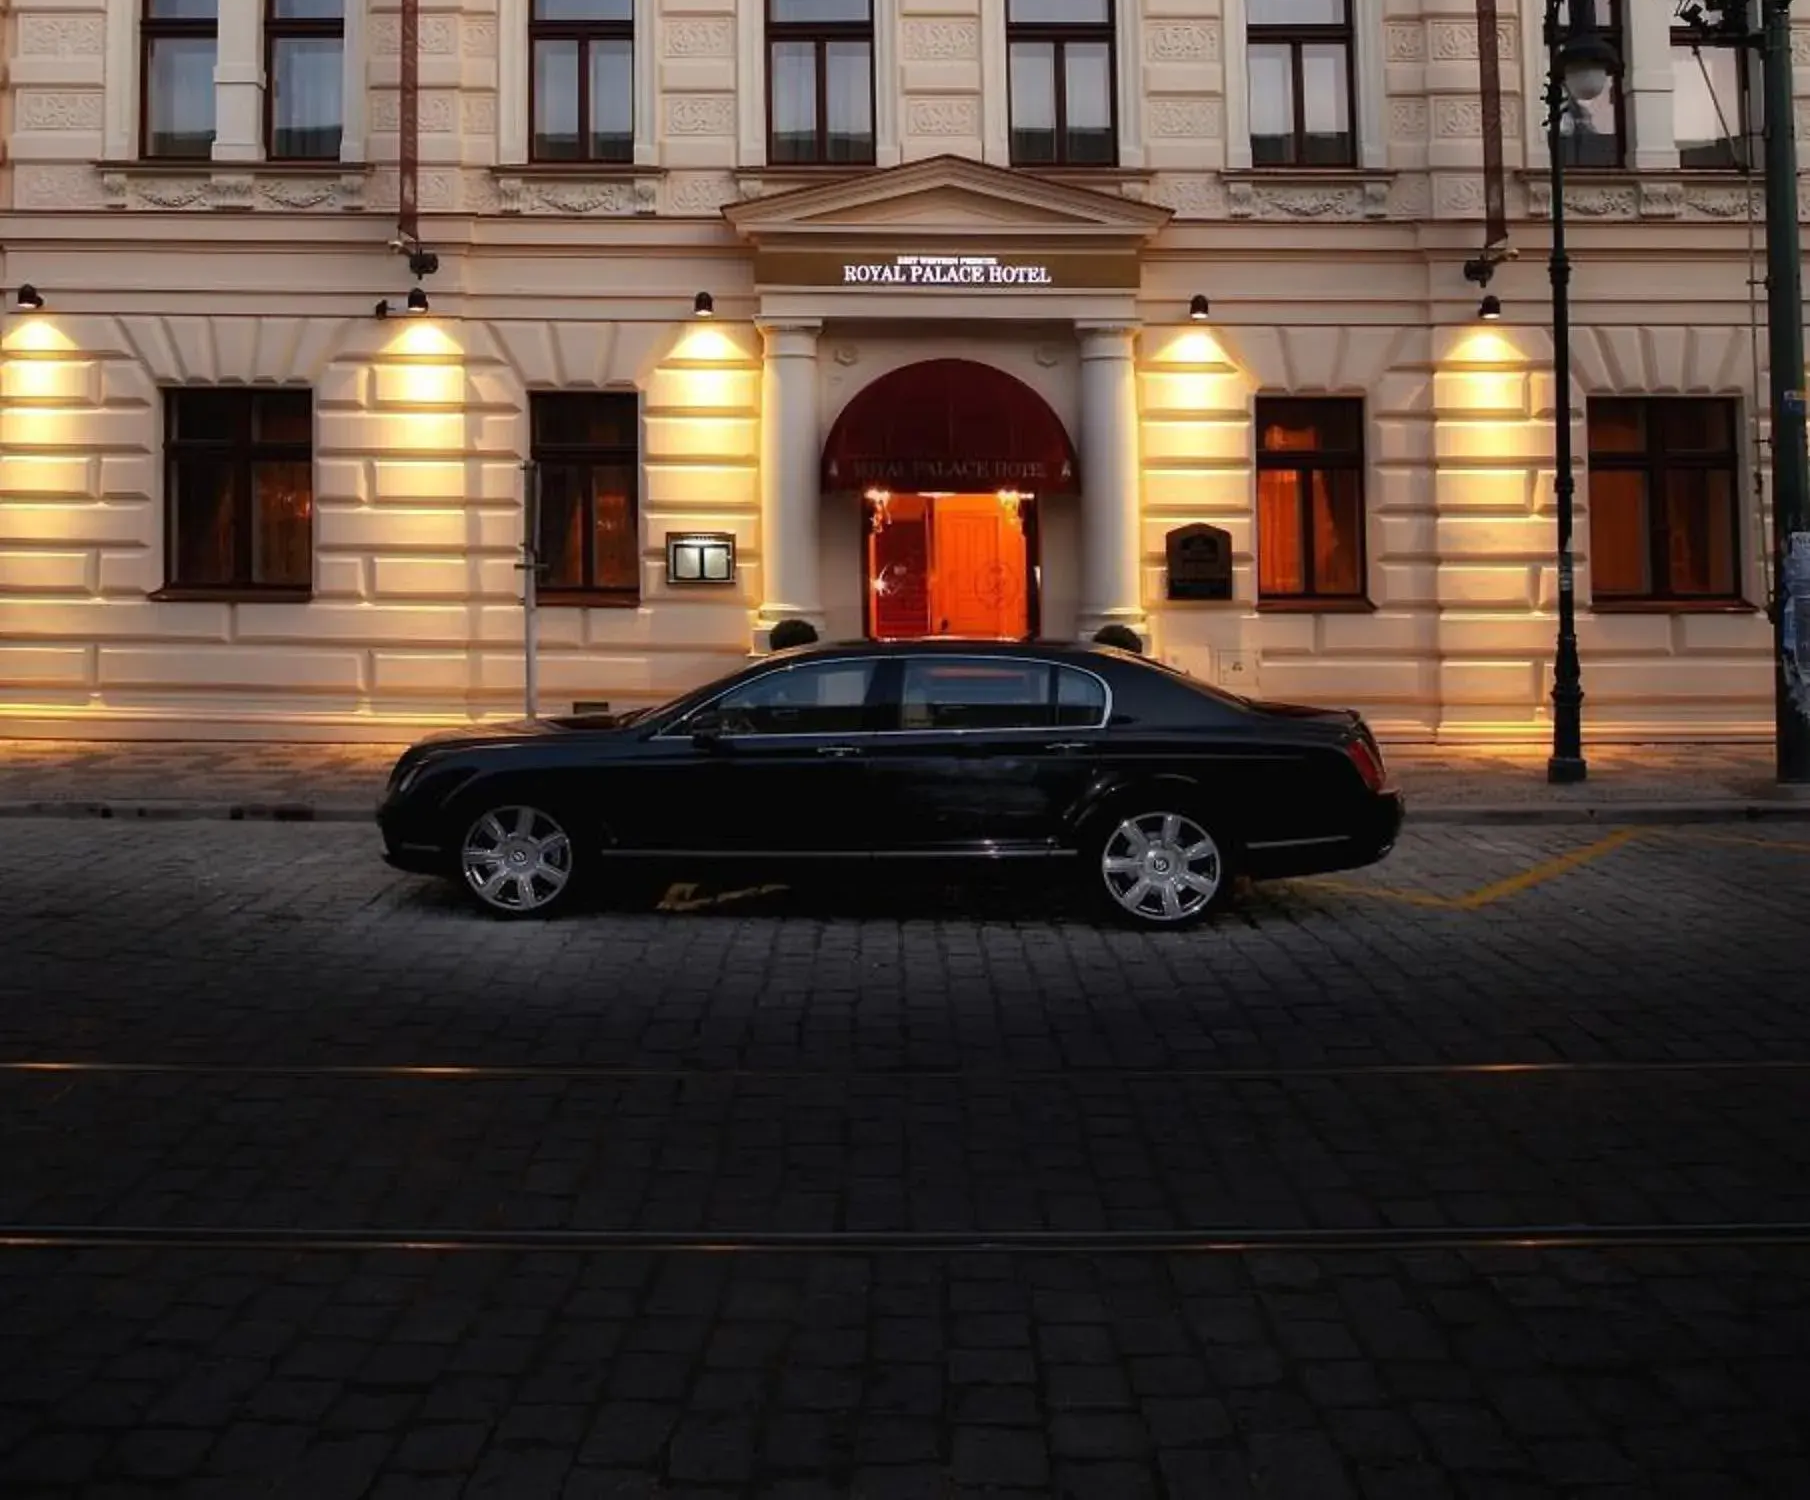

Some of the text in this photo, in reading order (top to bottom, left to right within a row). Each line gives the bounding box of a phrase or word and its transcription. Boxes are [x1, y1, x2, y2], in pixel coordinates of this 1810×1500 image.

[844, 265, 1052, 283] ROYAL PALACE HOTEL
